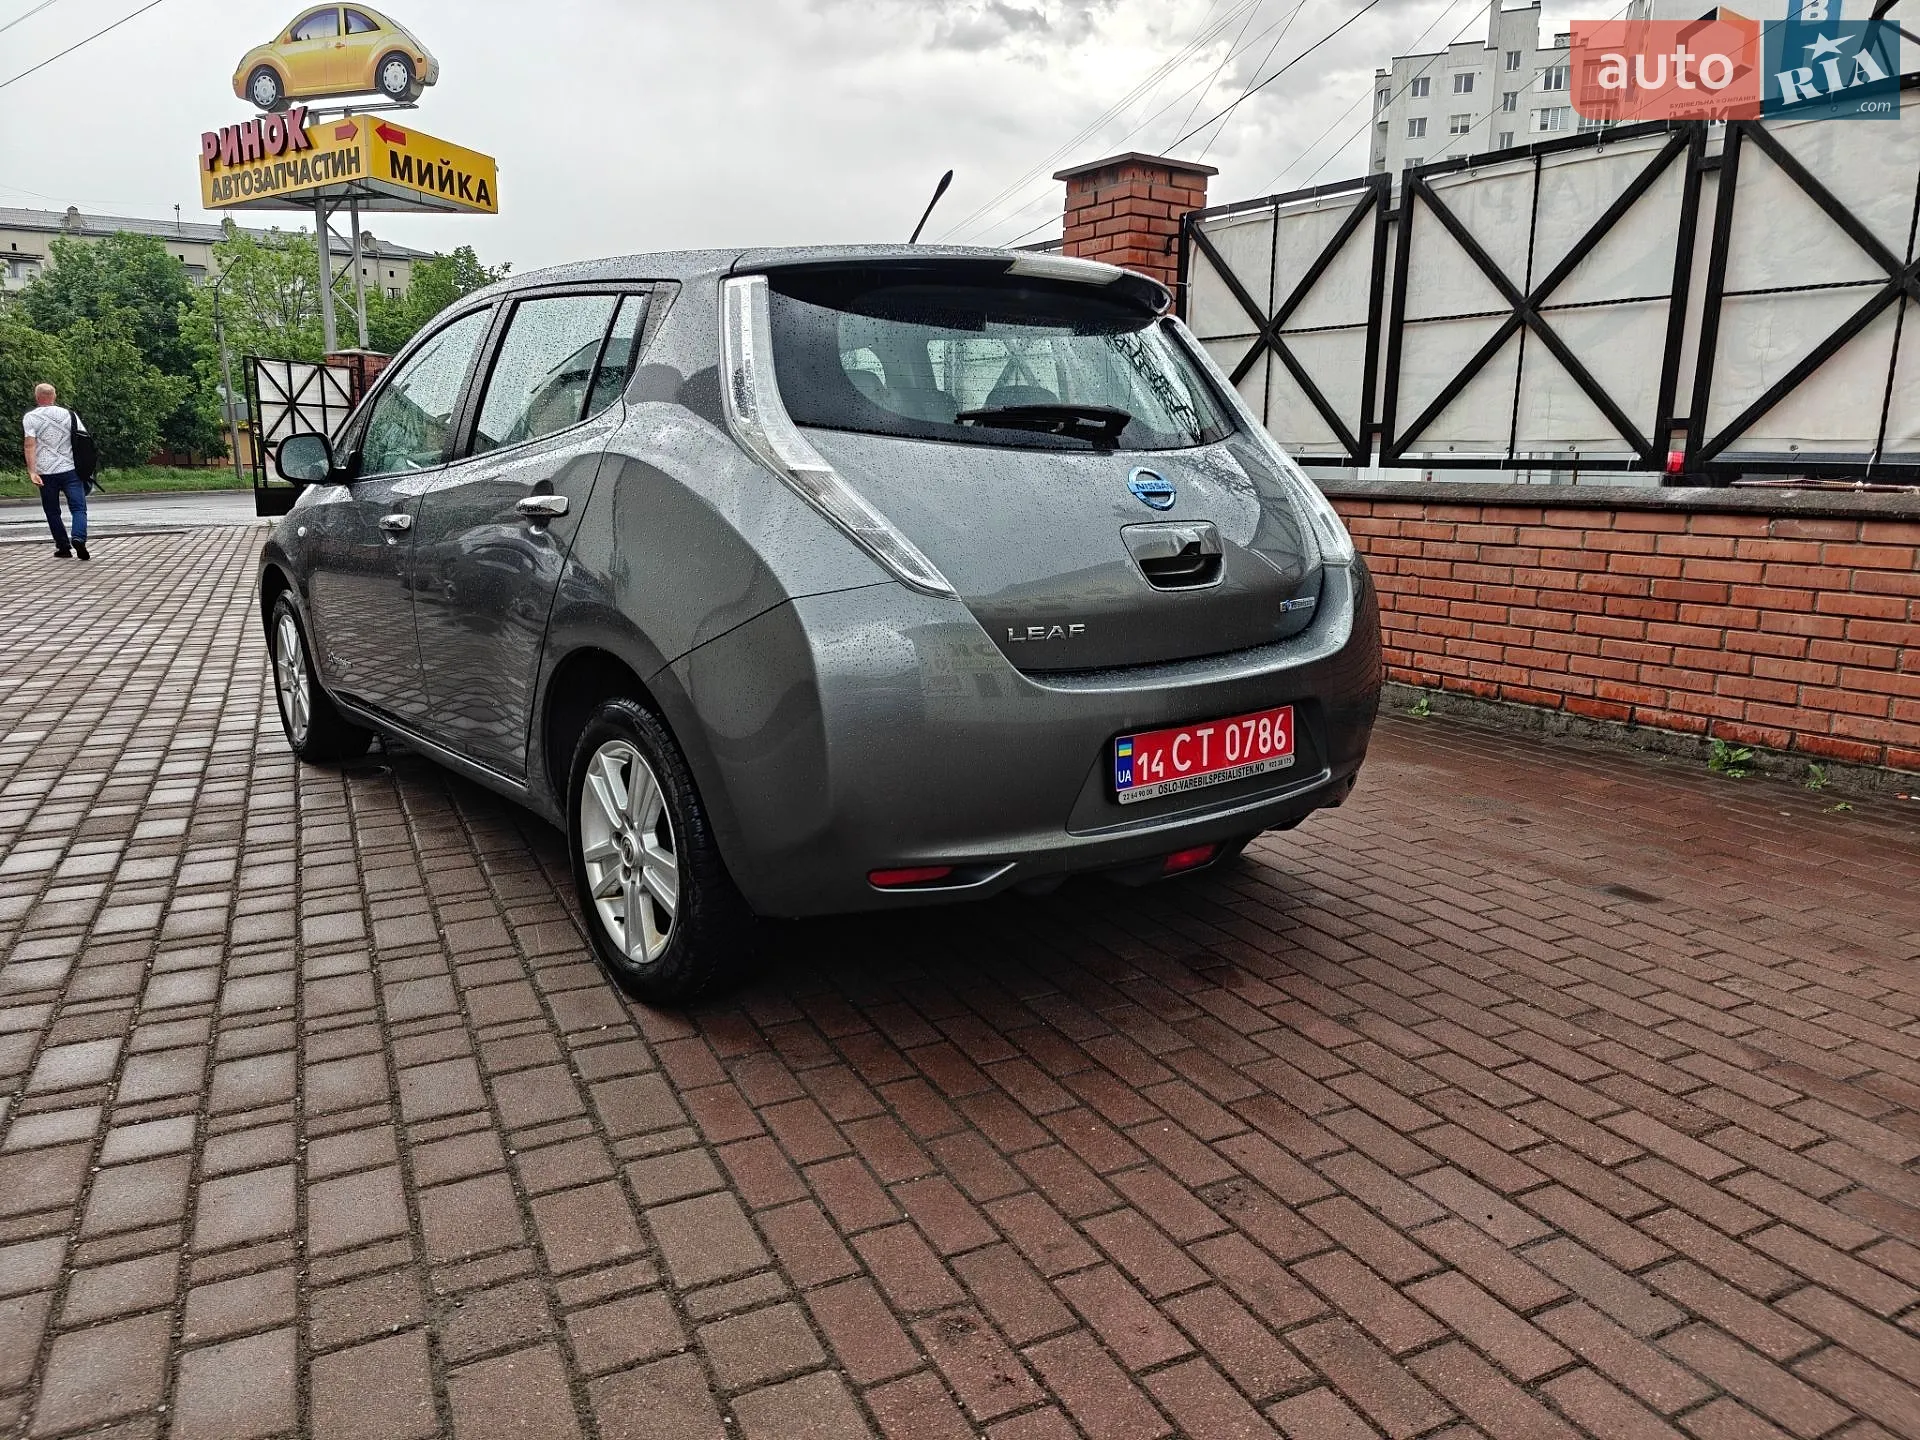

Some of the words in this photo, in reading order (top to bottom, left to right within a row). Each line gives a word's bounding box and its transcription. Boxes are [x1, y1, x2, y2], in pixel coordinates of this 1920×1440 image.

[201, 105, 312, 172] РИНОК
[210, 146, 362, 202] АВТОЗАПЧАСТИН
[389, 149, 492, 207] МИЙКА
[1134, 481, 1174, 491] NISSAN
[1007, 623, 1086, 643] LEAF
[1137, 749, 1164, 781] 14
[1172, 728, 1215, 772] CT
[1225, 713, 1287, 762] 0786
[1117, 770, 1132, 783] UA
